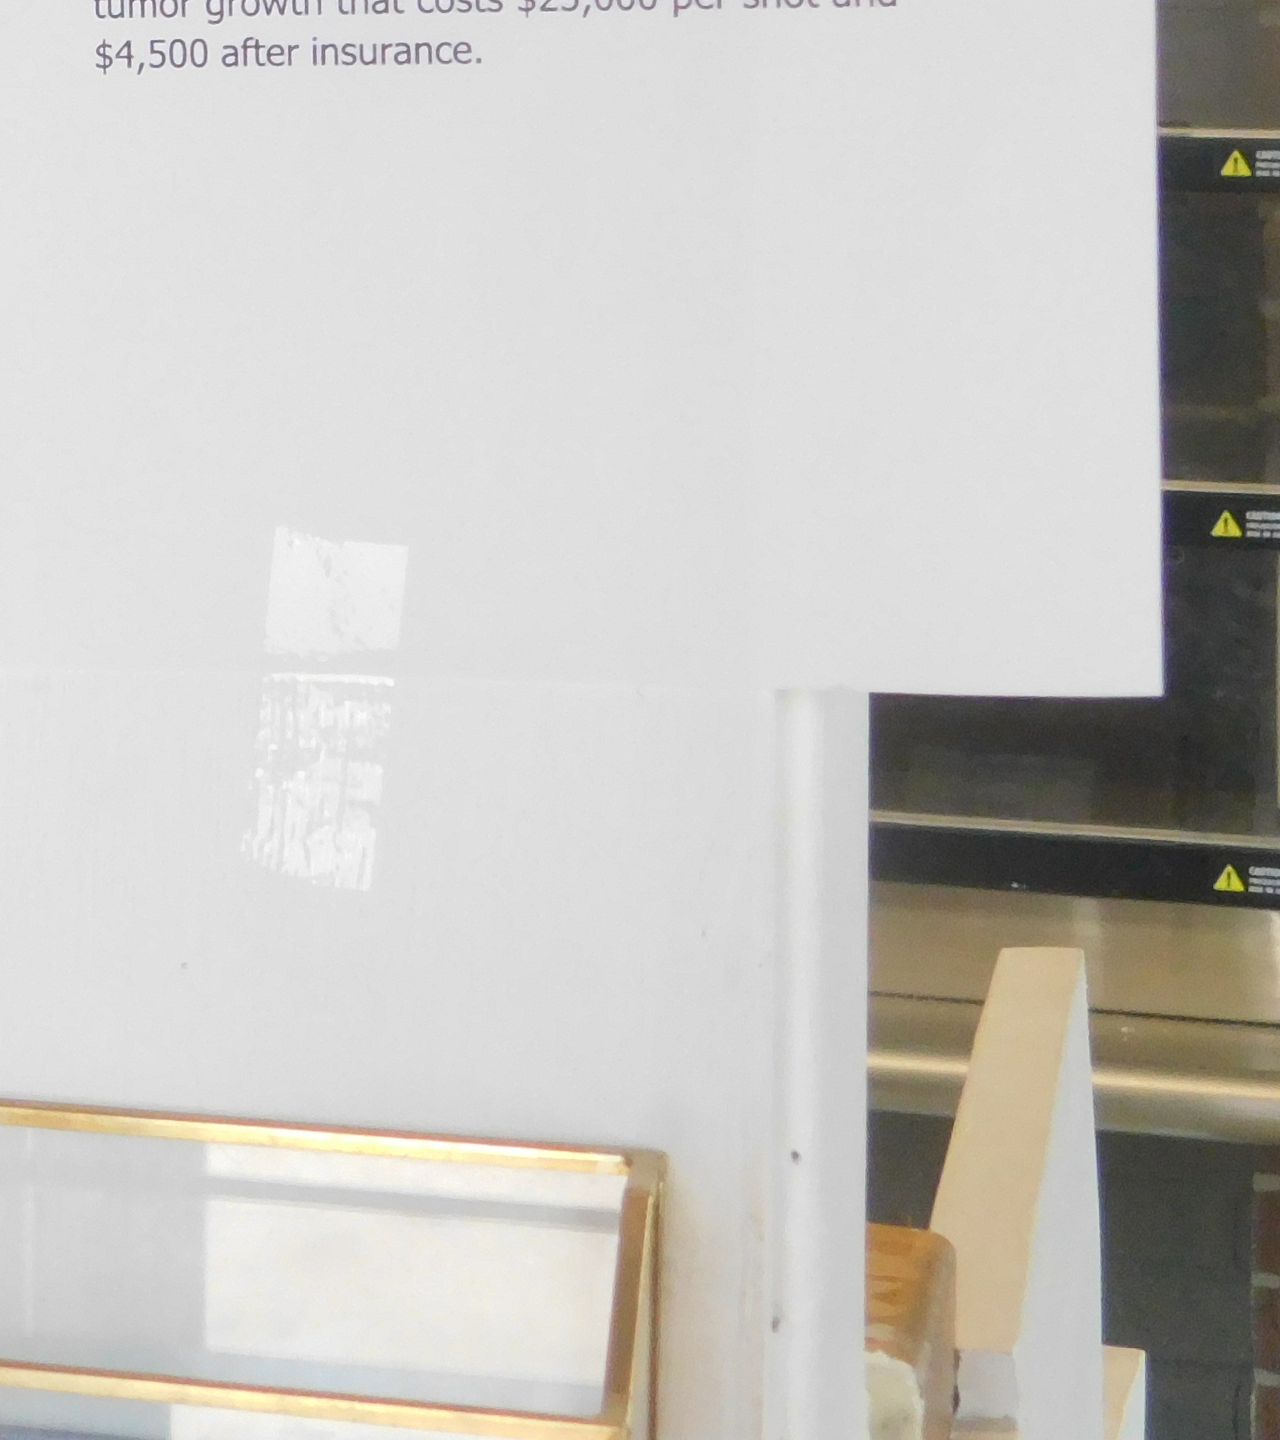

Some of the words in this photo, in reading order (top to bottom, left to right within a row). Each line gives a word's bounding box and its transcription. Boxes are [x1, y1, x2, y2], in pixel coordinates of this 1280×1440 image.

[96, 39, 208, 75] $4,500
[222, 37, 299, 67] after
[312, 37, 481, 66] insurance.
